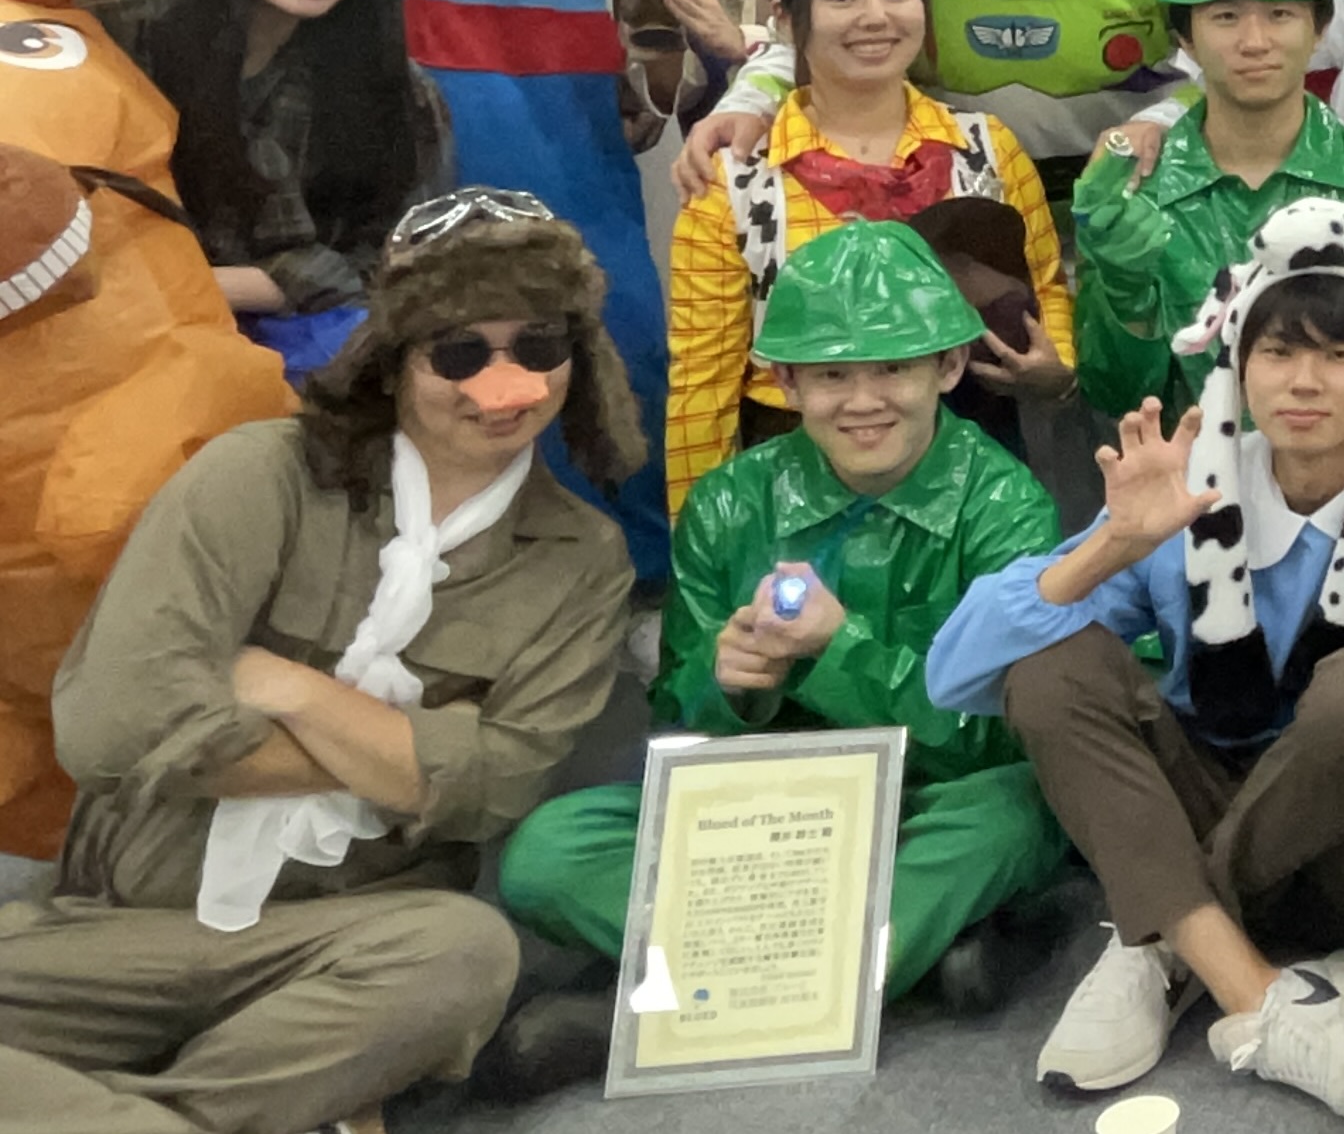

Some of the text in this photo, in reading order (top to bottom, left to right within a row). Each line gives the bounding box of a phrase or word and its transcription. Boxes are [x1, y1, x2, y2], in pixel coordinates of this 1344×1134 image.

[741, 814, 757, 827] of
[759, 812, 785, 826] The
[788, 808, 834, 823] Month
